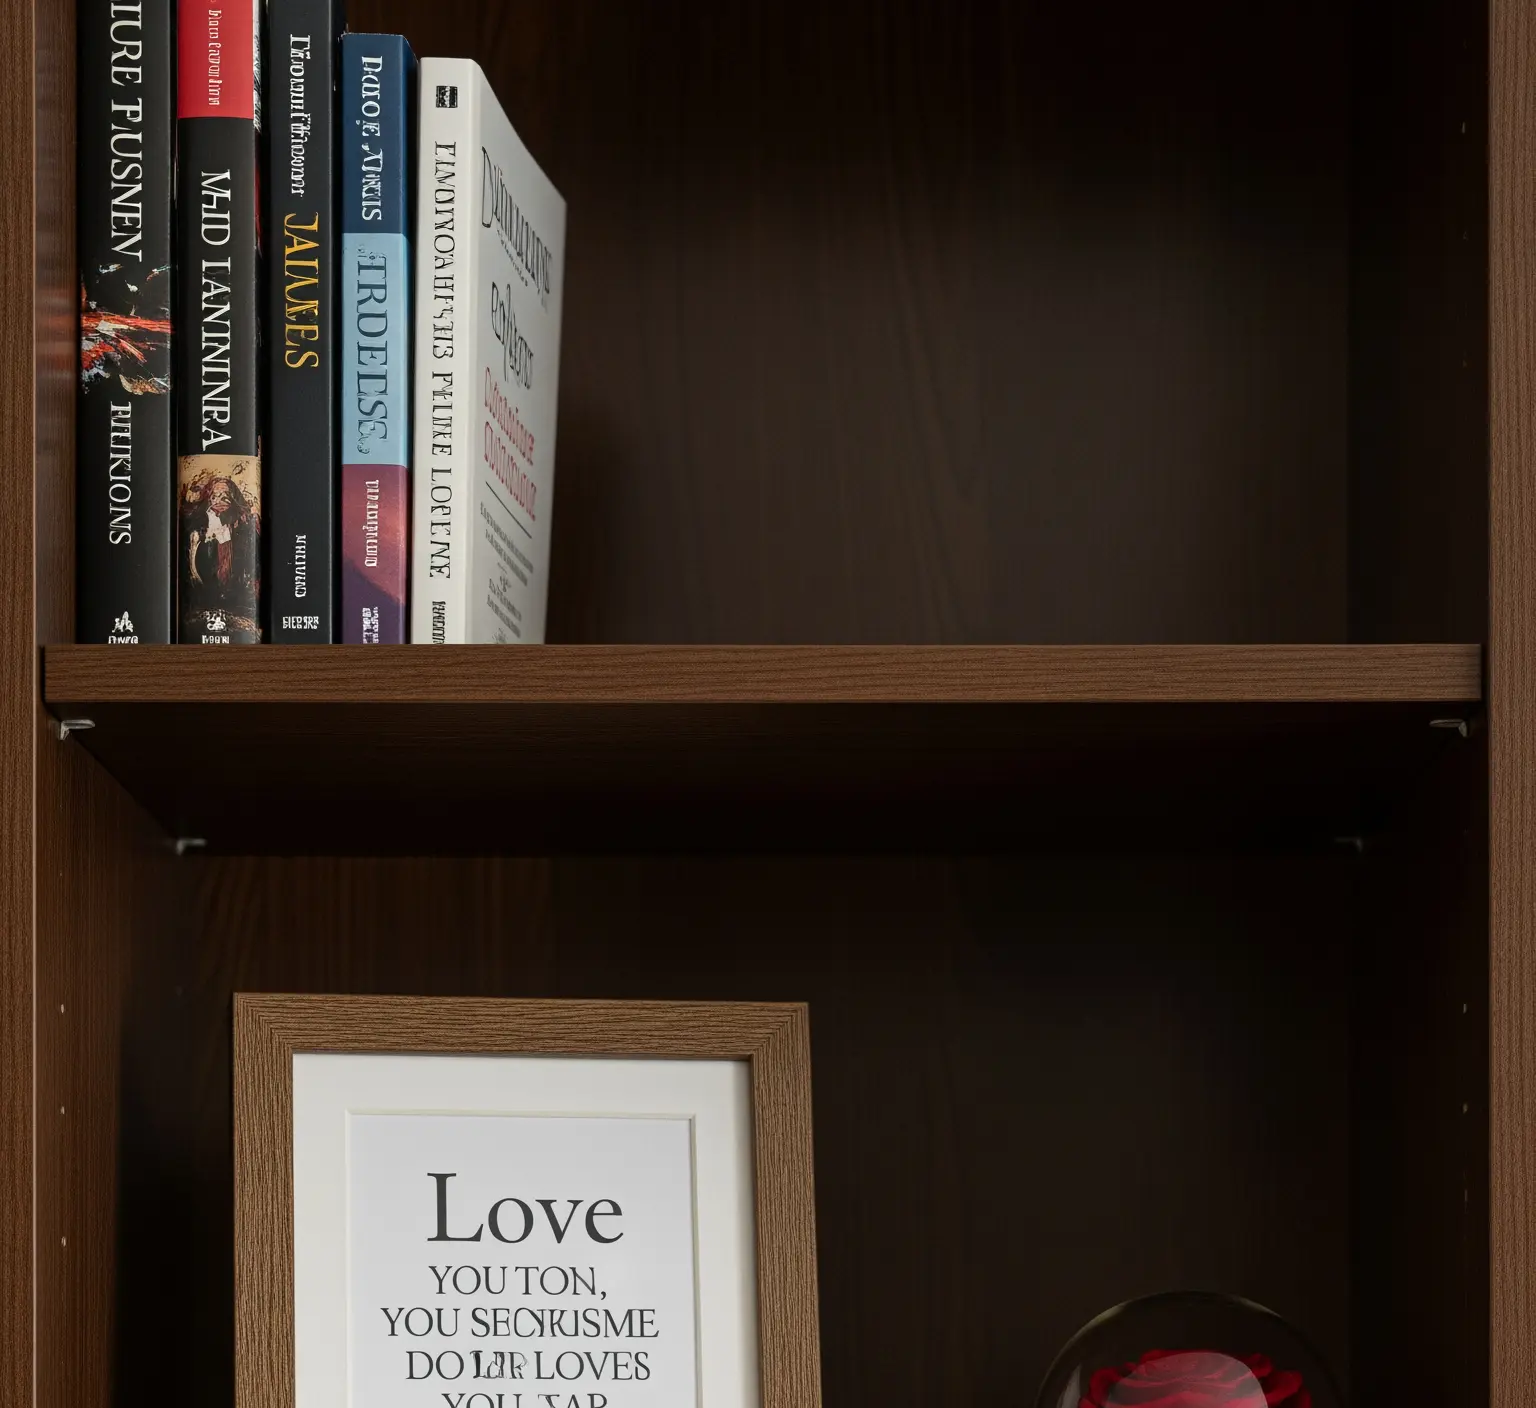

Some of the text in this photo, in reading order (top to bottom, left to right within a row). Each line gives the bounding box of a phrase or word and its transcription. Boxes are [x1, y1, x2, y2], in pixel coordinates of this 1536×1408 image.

[427, 1172, 624, 1244] Love
[428, 1265, 508, 1296] YOU
[380, 1307, 461, 1337] YOU
[405, 1350, 465, 1380] DO
[533, 1351, 651, 1381] LOVES
